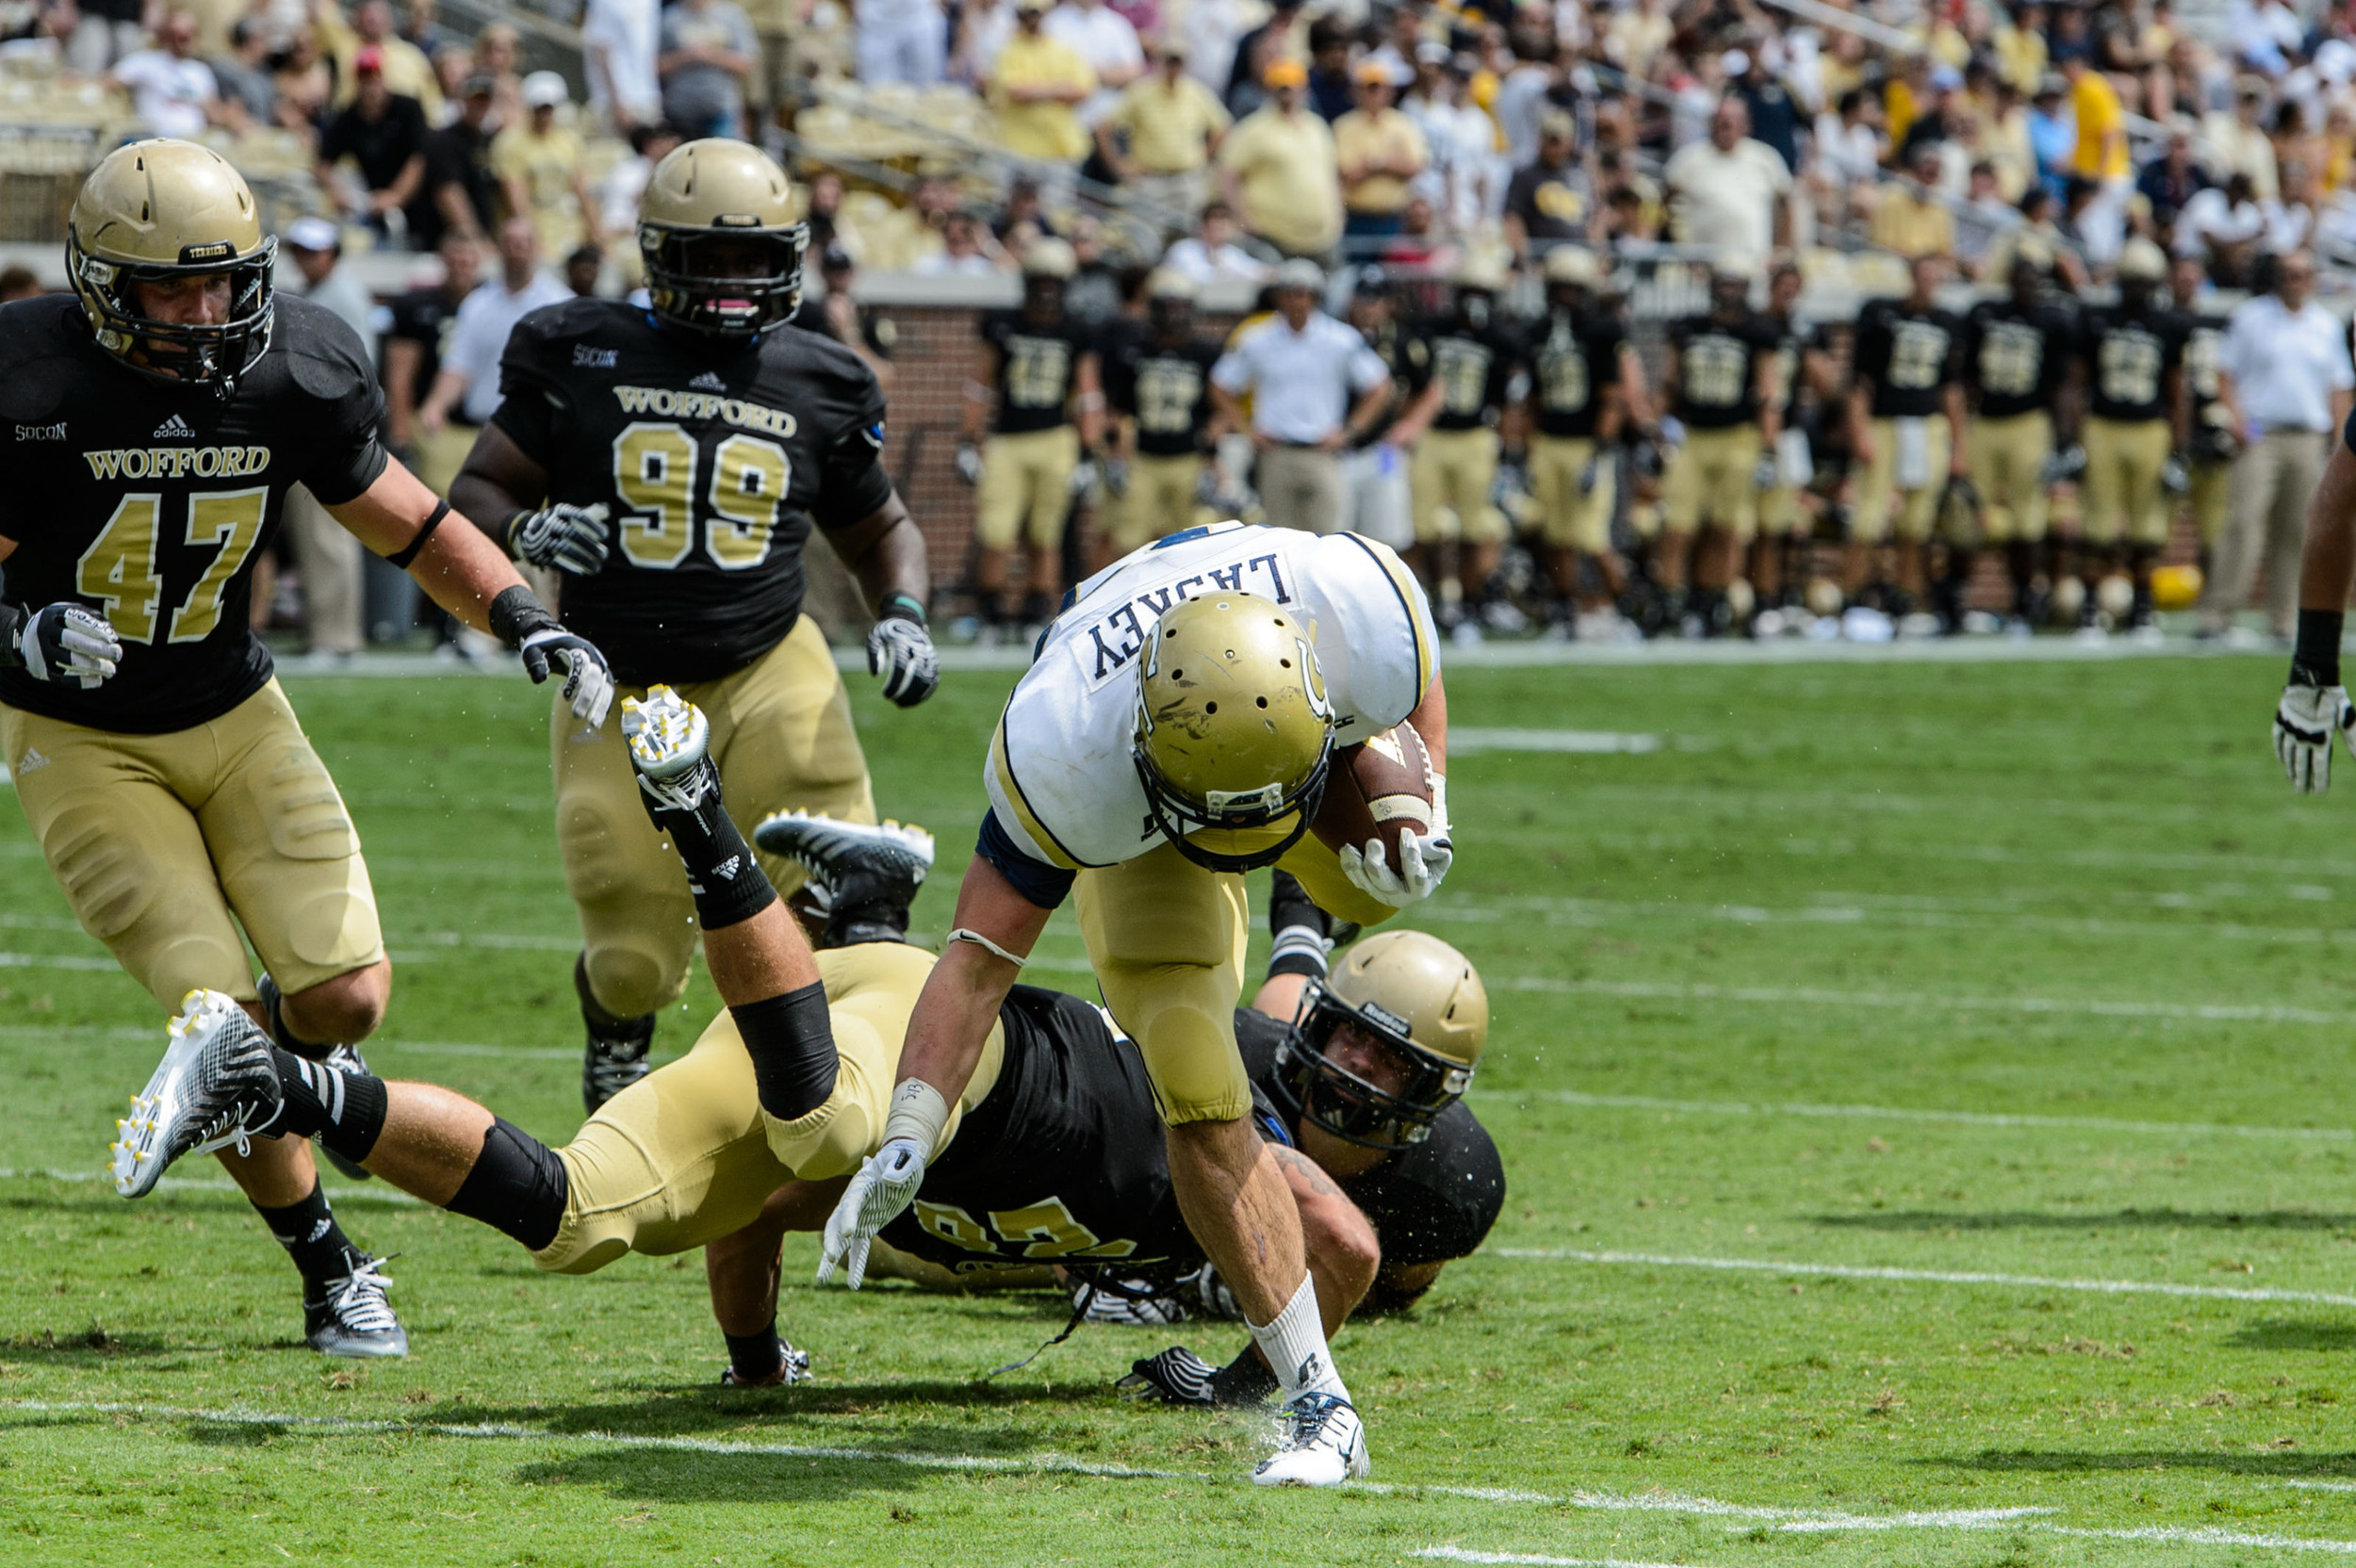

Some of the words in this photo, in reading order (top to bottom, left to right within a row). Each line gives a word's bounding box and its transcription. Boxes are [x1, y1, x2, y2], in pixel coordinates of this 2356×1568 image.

[189, 245, 227, 258] TERRIERS
[15, 422, 67, 441] SOCON
[154, 428, 195, 438] adidas
[613, 385, 797, 438] WOFFORD
[83, 447, 270, 480] WOFFORD
[613, 421, 793, 570] 99
[76, 485, 270, 645] 47
[1088, 553, 1291, 680] LAEY
